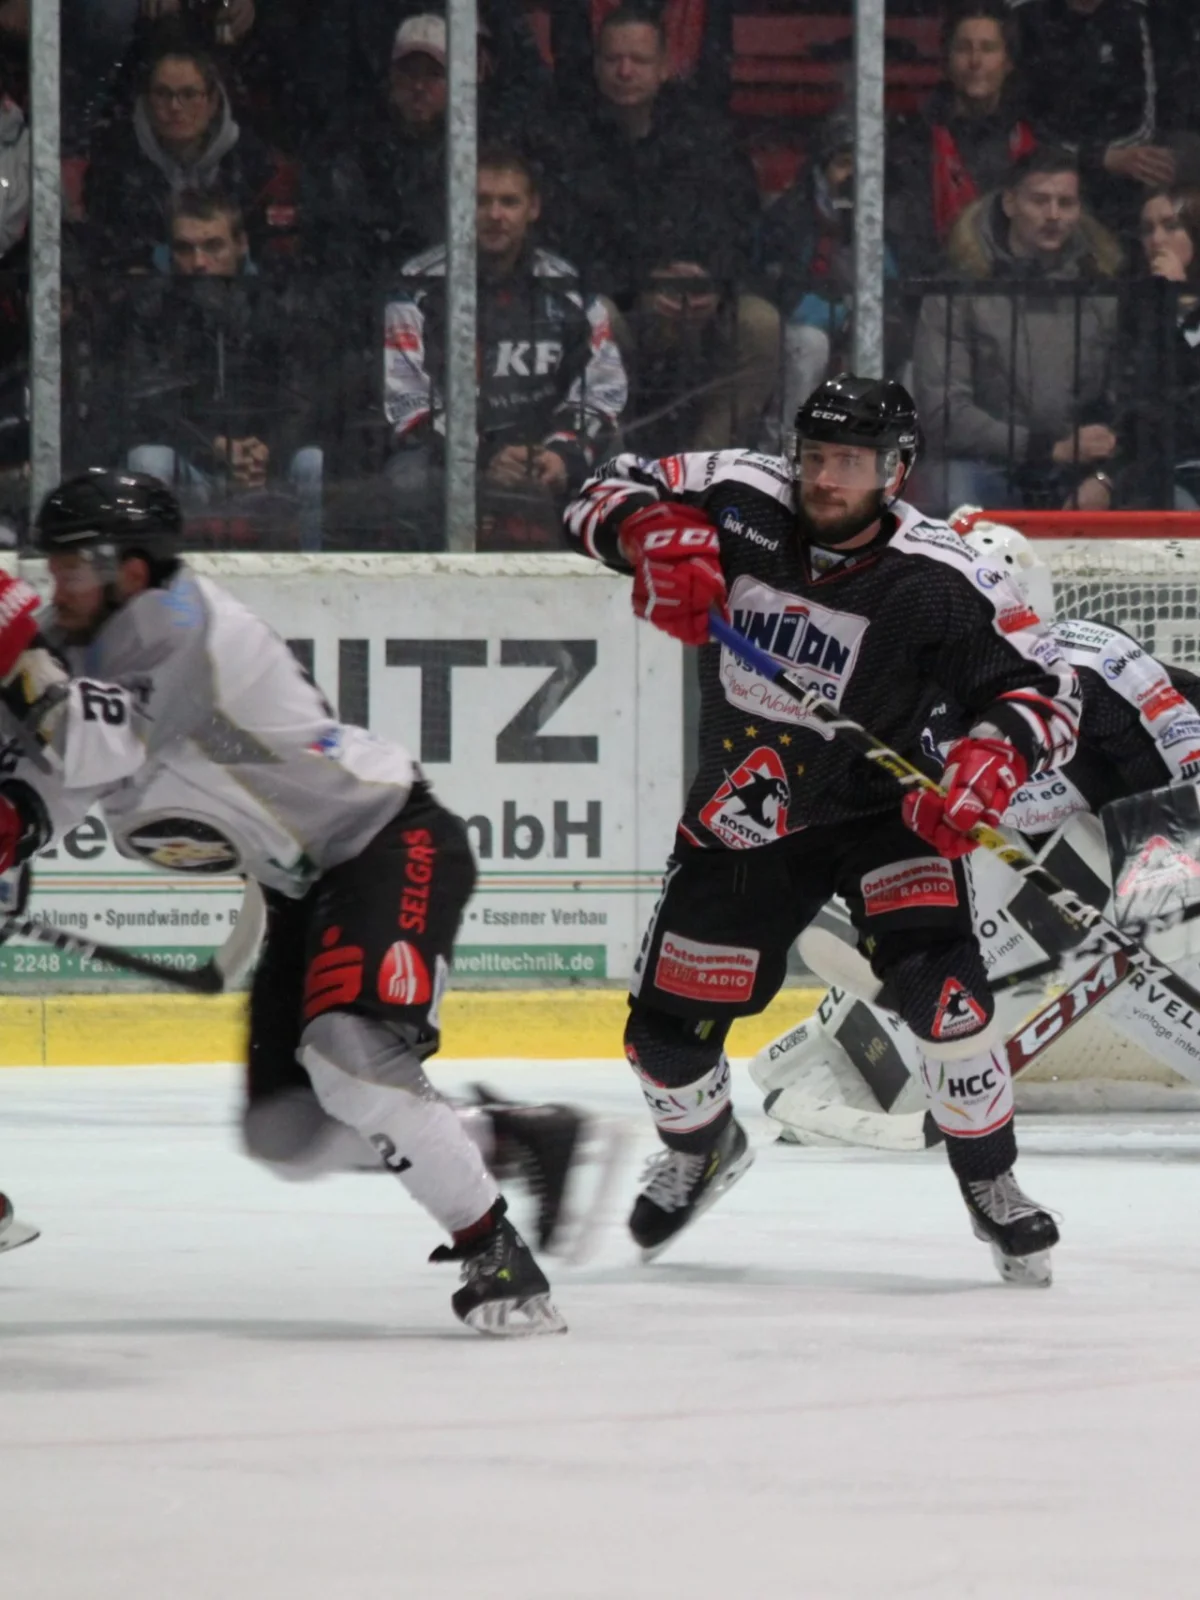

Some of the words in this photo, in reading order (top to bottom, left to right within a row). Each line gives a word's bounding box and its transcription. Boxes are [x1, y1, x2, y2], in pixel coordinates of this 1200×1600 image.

[811, 410, 848, 422] CCM
[745, 526, 780, 551] Nord
[732, 608, 852, 676] UNION
[1059, 629, 1110, 647] specht
[1040, 782, 1068, 801] eG
[105, 908, 211, 928] Spundwände
[482, 908, 547, 927] Essener
[551, 908, 608, 927] Verbau
[13, 954, 61, 973] 2248
[455, 952, 595, 972] welttechnik.de
[1014, 953, 1119, 1056] CM
[1132, 1006, 1173, 1042] vintage
[947, 1068, 997, 1098] HCC
